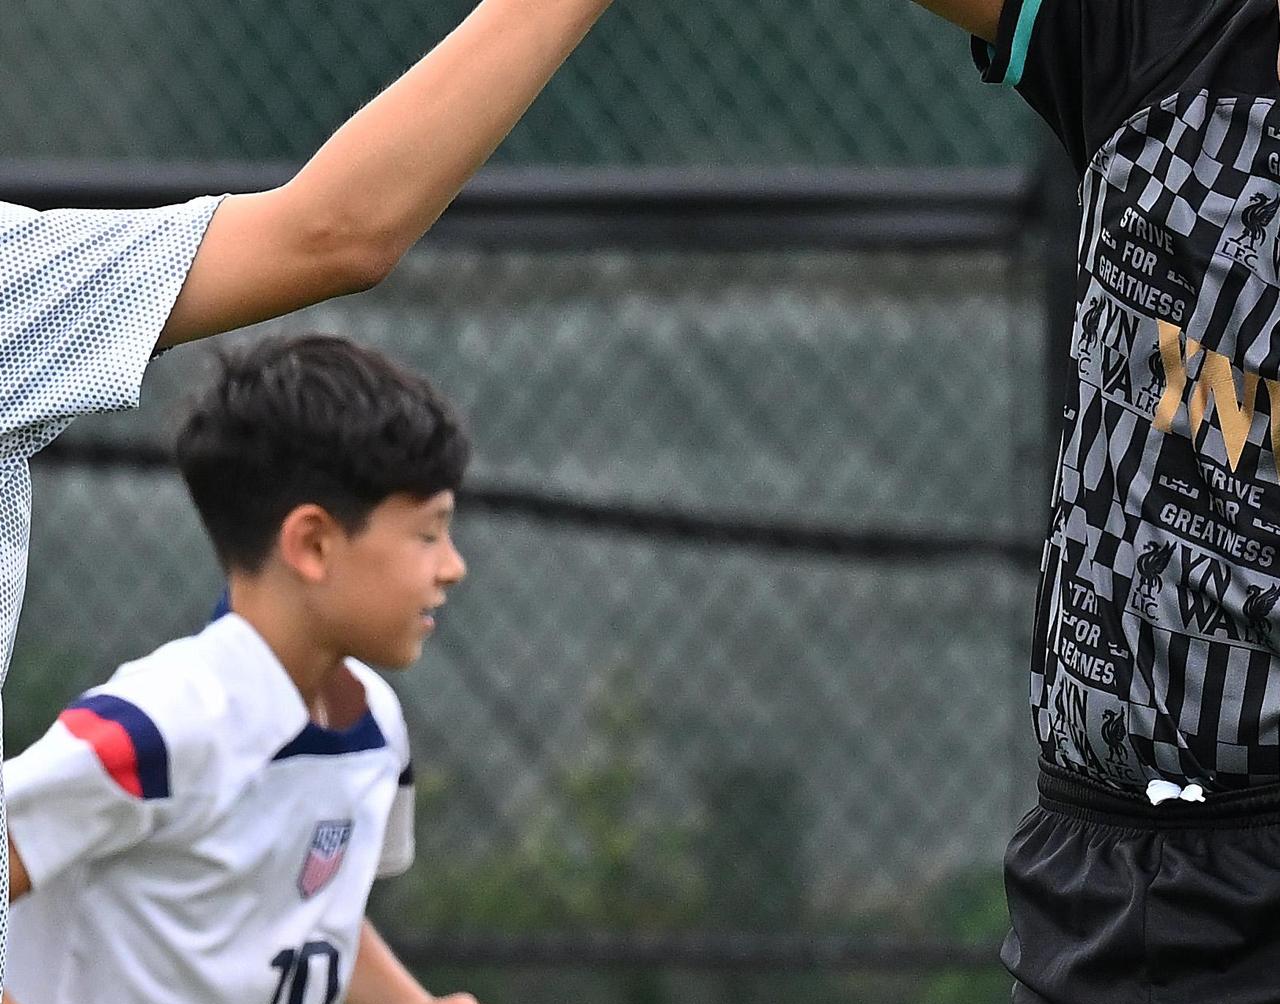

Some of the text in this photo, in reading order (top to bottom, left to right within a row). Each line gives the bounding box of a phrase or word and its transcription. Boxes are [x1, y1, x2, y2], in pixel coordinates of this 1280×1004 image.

[1120, 207, 1175, 255] STRIVE
[1122, 241, 1158, 276] FOR
[1099, 255, 1185, 322] GREATNESS
[1197, 460, 1265, 509] TRIVE
[1159, 503, 1276, 567] GREATNESS
